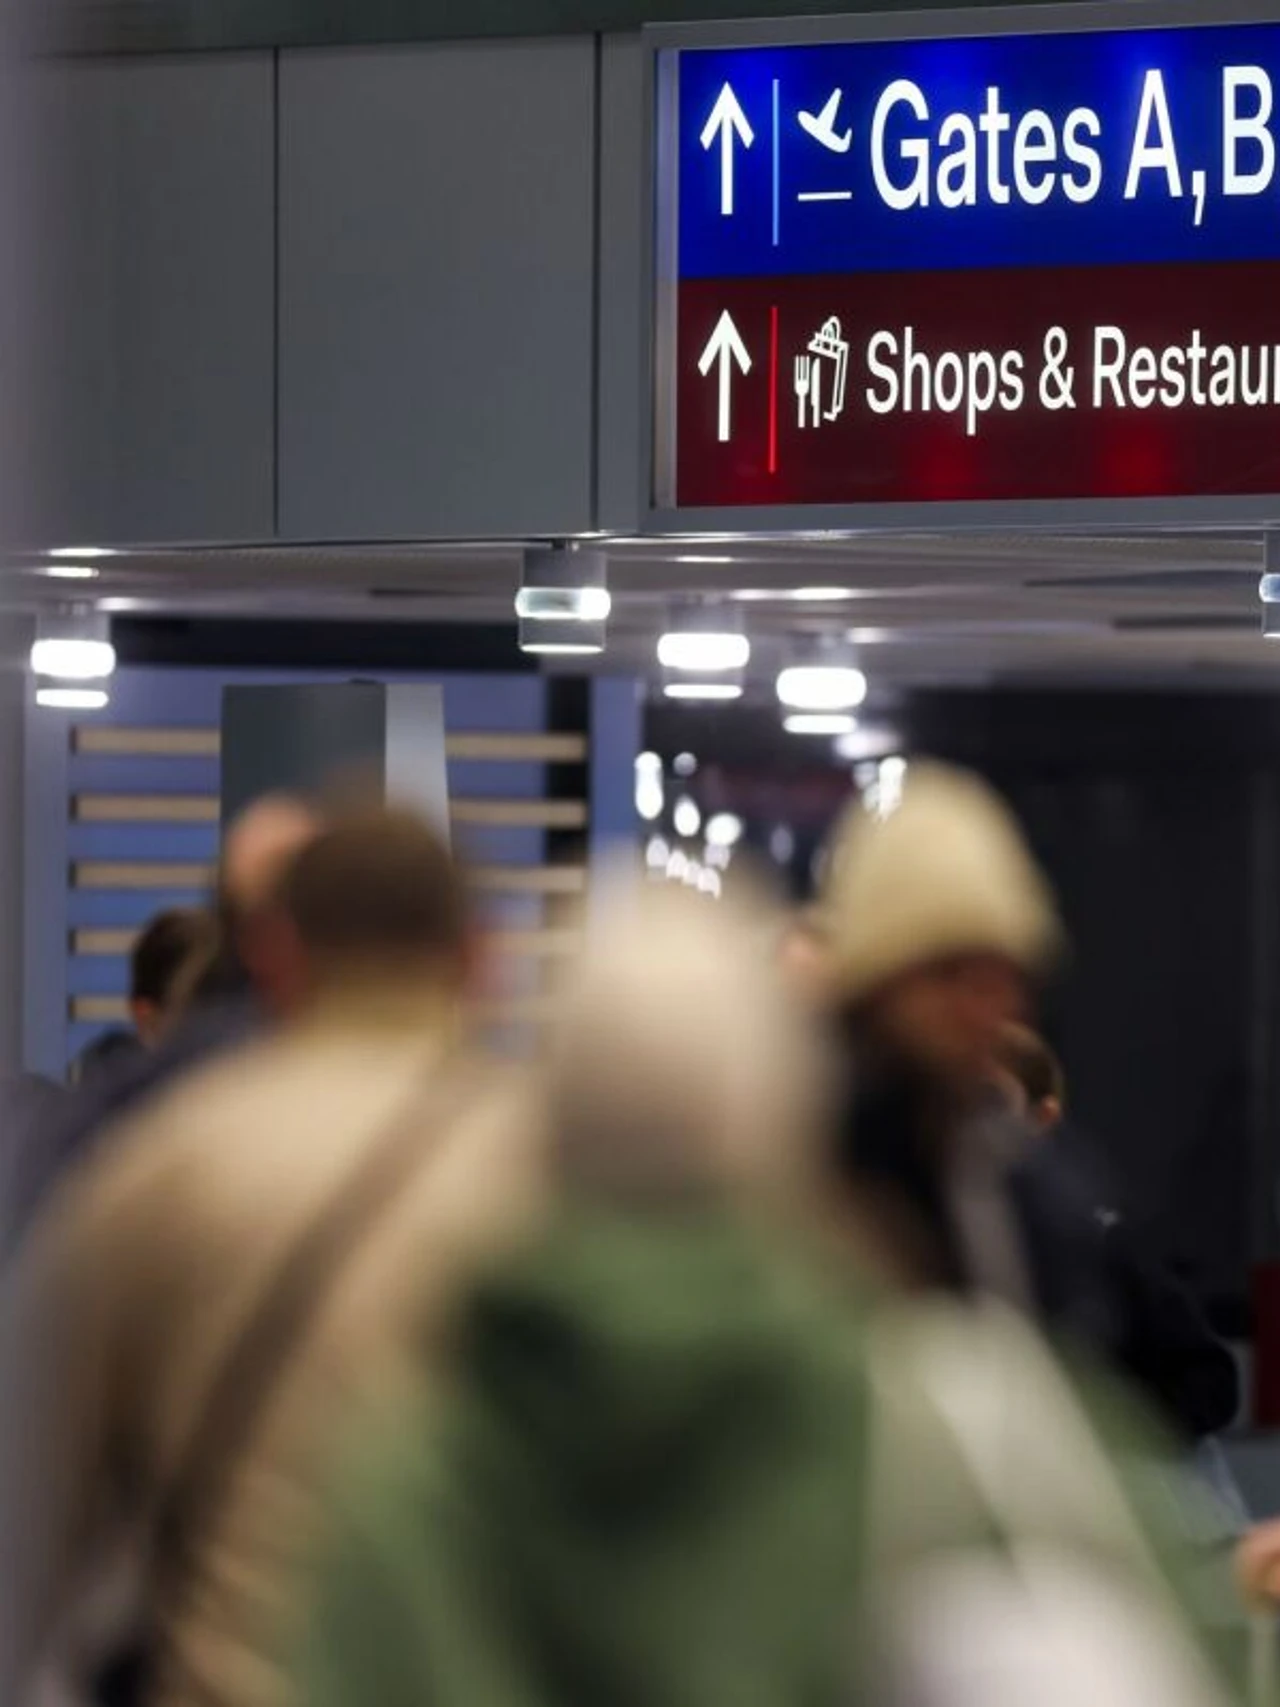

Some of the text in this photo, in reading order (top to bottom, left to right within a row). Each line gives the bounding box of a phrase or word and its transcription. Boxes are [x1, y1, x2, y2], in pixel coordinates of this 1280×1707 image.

[871, 79, 1103, 211] Gates
[866, 326, 1025, 437] Shops
[1038, 326, 1078, 410] &
